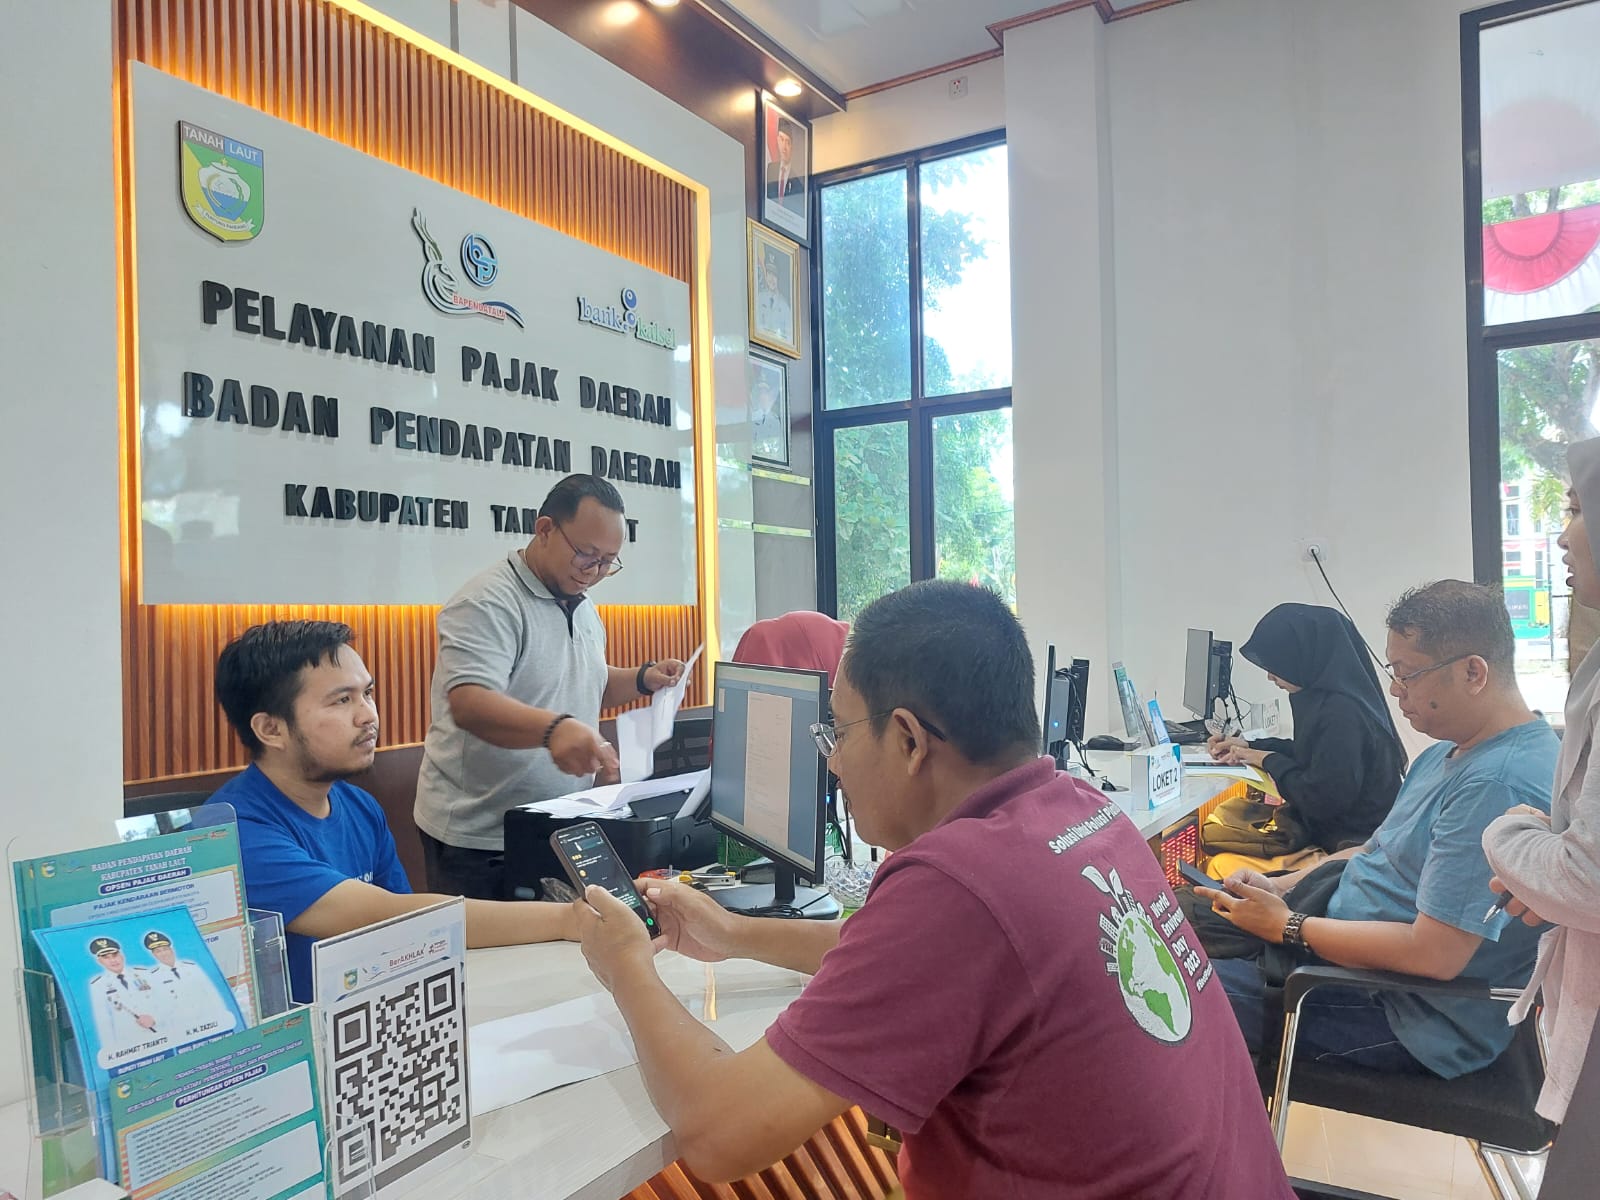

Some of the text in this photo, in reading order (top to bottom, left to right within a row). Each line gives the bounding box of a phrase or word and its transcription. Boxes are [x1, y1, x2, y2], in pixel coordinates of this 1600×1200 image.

[183, 125, 258, 161] TANAH LAUT
[453, 292, 507, 320] BAPENDATALA
[580, 297, 621, 329] bank
[202, 280, 672, 428] PELAYANAN PAJAK DAERAH
[183, 371, 681, 490] BADAN PENDAPATAN DAERAH
[284, 482, 537, 536] KABUPATEN TAN
[1152, 767, 1178, 792] LOKET 2
[1048, 827, 1080, 854] Solusi
[1084, 809, 1110, 833] Polusi
[91, 845, 193, 872] BADAN PENDAPATAN DAERAH
[144, 861, 168, 872] TANAH
[168, 857, 186, 868] LAUT
[105, 869, 187, 892] OPSEN PAJAK DAERAH
[93, 883, 195, 910] PAJAK KENDARAAN BERMOTOR
[1150, 891, 1170, 919] World
[1161, 906, 1185, 938] Environ
[389, 948, 425, 967] BerAKHLAK
[1171, 935, 1190, 958] Day
[1183, 949, 1201, 977] 2023
[142, 1036, 168, 1050] TRIANTO
[178, 1083, 224, 1105] PERHITUNGAN
[223, 1074, 244, 1088] OPSEN
[244, 1066, 263, 1079] PAJAK
